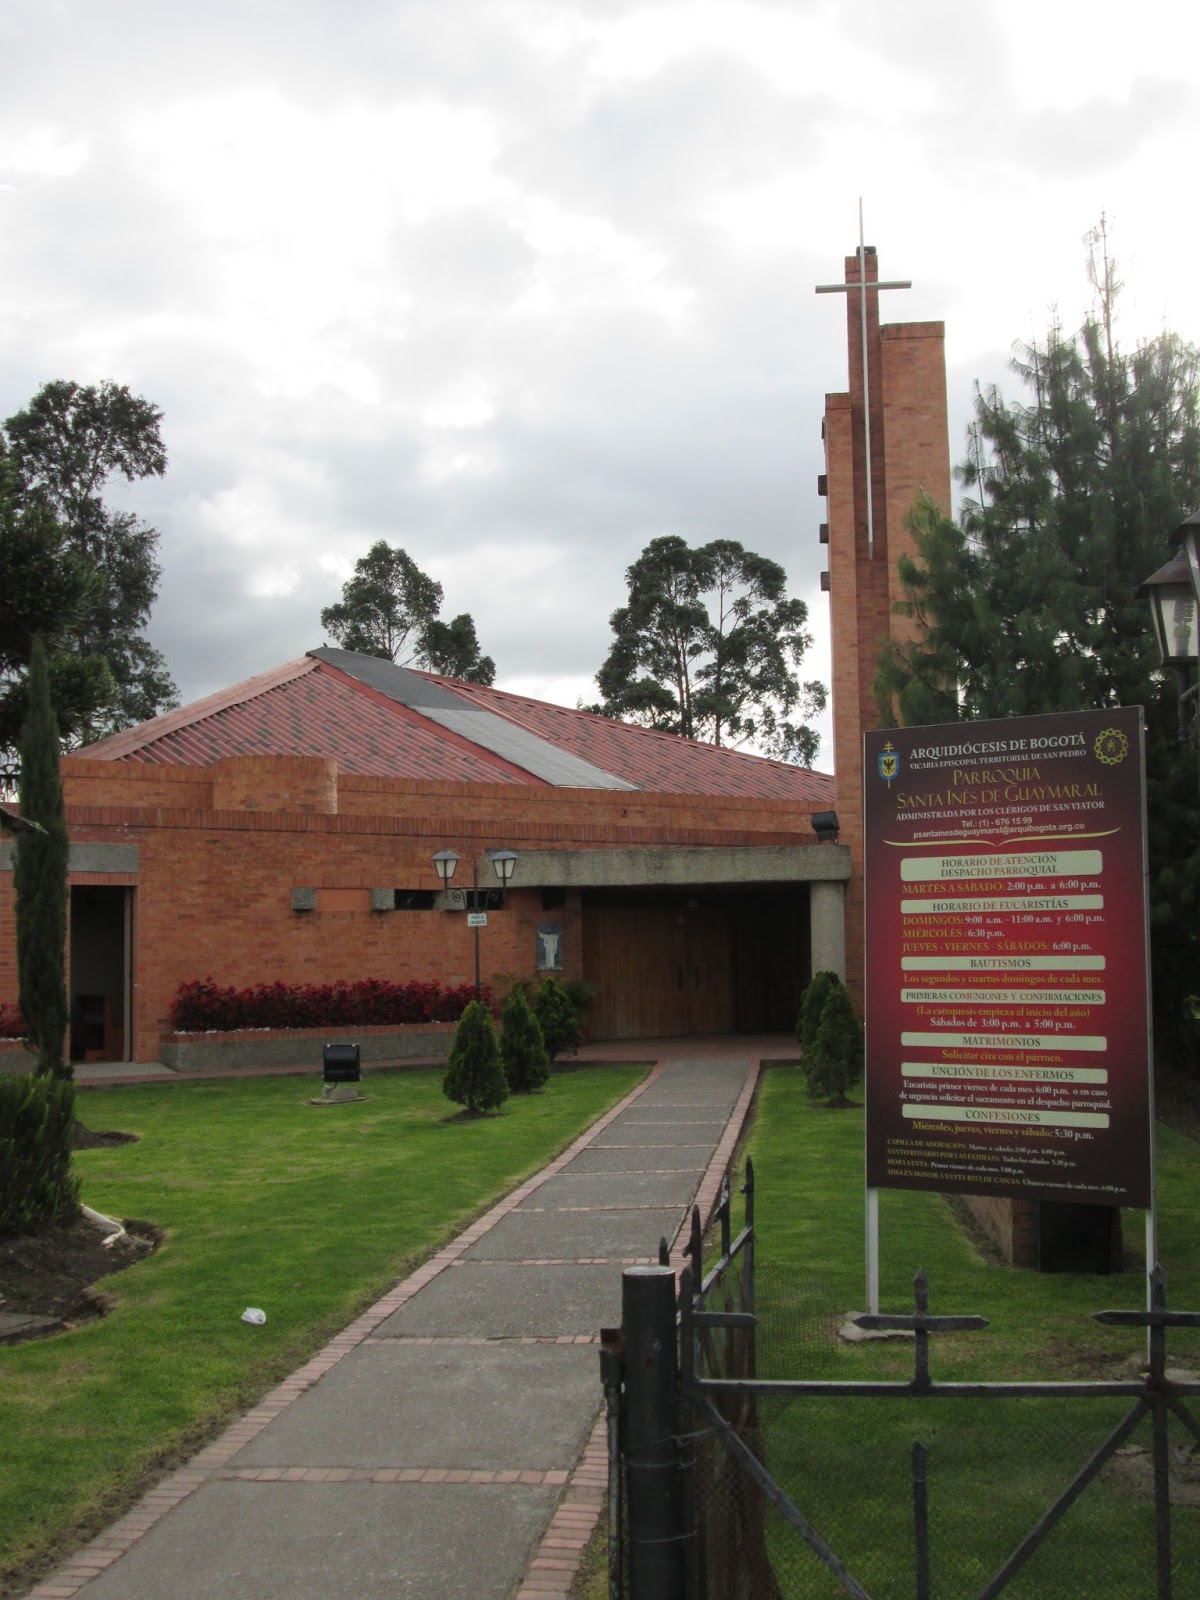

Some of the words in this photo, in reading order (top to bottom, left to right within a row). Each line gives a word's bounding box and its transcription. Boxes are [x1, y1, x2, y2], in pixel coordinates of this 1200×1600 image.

[910, 741, 1006, 760] ARQUIDIÓCESIS
[1010, 740, 1028, 750] DE
[1030, 732, 1086, 749] BOGOTÁ
[910, 761, 938, 770] VICARIA
[940, 758, 978, 768] EPISCOPAL
[980, 753, 1030, 764] TERRITORIAL
[1043, 751, 1058, 759] SAN
[1060, 750, 1086, 758] PEDRO
[953, 767, 1040, 786] PARROQUIA
[897, 793, 942, 808] SANTA
[947, 789, 977, 806] INÉS
[981, 790, 1001, 803] DE
[1004, 783, 1102, 801] GUAYMARAL
[896, 810, 958, 820] ADMINISTRADA
[995, 804, 1038, 814] CLÉRIGOS
[1053, 803, 1070, 811] SAN
[1070, 801, 1104, 810] VIATOR
[979, 820, 989, 828] (1)
[942, 859, 987, 868] HORARIO
[1005, 854, 1056, 864] ATENCIÓN
[942, 868, 992, 877] DESPACHO
[994, 865, 1058, 875] PARROQUIAL
[902, 884, 946, 894] MARTES
[948, 884, 955, 892] A
[957, 880, 1004, 892] SÁBADO:
[1007, 882, 1025, 890] 2:00
[1027, 884, 1046, 893] p.m.
[1060, 880, 1078, 888] 6:00
[1081, 881, 1101, 891] p.m.
[932, 902, 980, 911] HORARIO
[983, 902, 998, 910] DE
[1000, 898, 1068, 910] EUCARISTÍAS
[903, 916, 964, 925] DOMINGOS:
[1012, 915, 1034, 923] 11:00
[1056, 916, 1062, 925] y
[1066, 914, 1084, 922] 6:00
[1086, 916, 1104, 924] p.m.
[968, 929, 984, 937] 6:30
[986, 931, 1005, 940] p.m.
[902, 942, 938, 953] JUEVES
[944, 942, 989, 950] VIERNES
[997, 940, 1049, 950] SÁBADOS:
[1073, 944, 1092, 952] p.m.
[970, 959, 1031, 968] BAUTISMOS
[904, 974, 919, 982] Los
[921, 974, 959, 985] segundos
[960, 977, 966, 985] y
[1002, 974, 1044, 985] domingos
[1048, 974, 1058, 982] de
[1060, 974, 1080, 982] cada
[1020, 993, 1102, 1001] CONFIRMACIONES
[933, 1008, 976, 1018] catequesis
[978, 1008, 1013, 1018] empieza
[1016, 1008, 1024, 1016] al
[1026, 1008, 1052, 1016] inicio
[1054, 1008, 1068, 1016] del
[930, 1017, 966, 1026] Sábados
[967, 1018, 977, 1026] de
[981, 1019, 1000, 1027] 3:00
[1002, 1022, 1021, 1030] p.m.
[1034, 1020, 1054, 1028] 5:00
[1056, 1022, 1076, 1031] p.m.
[963, 1036, 1040, 1046] MATRIMONIOS
[942, 1050, 978, 1060] Solicitar
[980, 1052, 996, 1060] cita
[1016, 1052, 1024, 1060] el
[932, 1066, 974, 1076] UNCIÓN
[992, 1069, 1012, 1078] LOS
[1014, 1070, 1074, 1080] ENFERMOS
[938, 1082, 962, 1091] primer
[990, 1083, 998, 1091] de
[1000, 1084, 1016, 1092] cada
[1053, 1088, 1070, 1096] p.m.
[900, 1091, 908, 1099] de
[909, 1093, 938, 1101] urgencia
[939, 1093, 966, 1102] solicitar
[1028, 1096, 1034, 1104] el
[1036, 1097, 1070, 1108] despacho
[1072, 1100, 1112, 1110] parroquial.
[966, 1110, 1040, 1122] CONFESIONES
[912, 1120, 954, 1132] Miércoles,
[955, 1124, 982, 1134] jueves,
[984, 1126, 1013, 1134] viernes
[1014, 1129, 1020, 1137] y
[1022, 1127, 1052, 1137] sábado:
[1054, 1129, 1073, 1138] 5:30
[1075, 1132, 1094, 1141] p.m.
